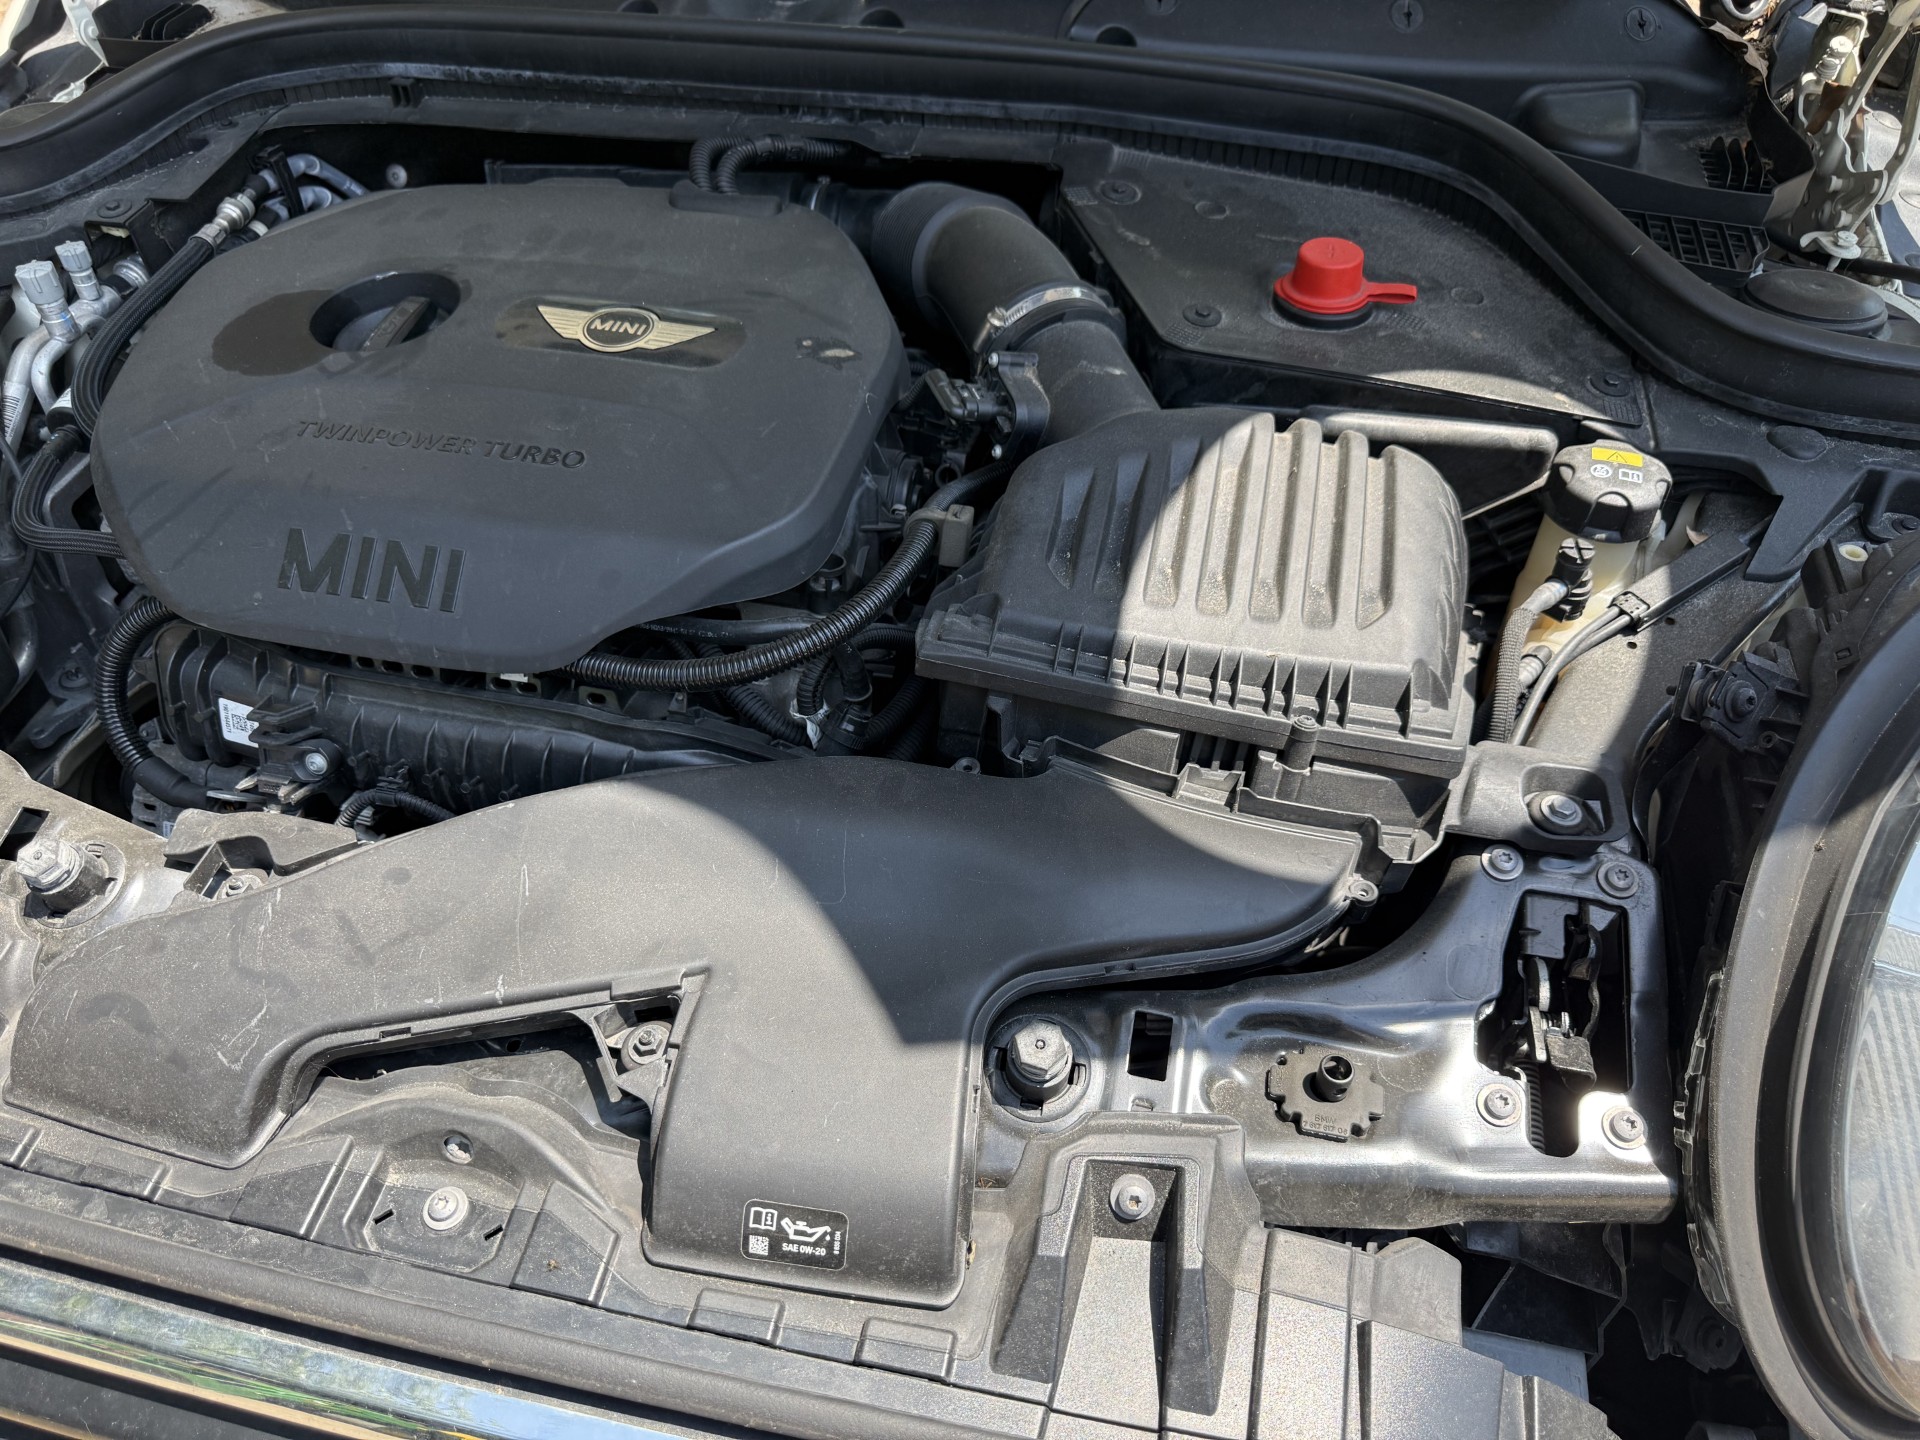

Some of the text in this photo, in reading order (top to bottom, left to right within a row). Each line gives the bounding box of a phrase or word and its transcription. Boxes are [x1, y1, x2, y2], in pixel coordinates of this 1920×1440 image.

[590, 318, 647, 336] MINI
[296, 420, 586, 469] TWINPOWER TURBO
[277, 527, 466, 613] MINI
[1314, 1114, 1337, 1124] BMW
[782, 1242, 826, 1256] SAE 0W-20
